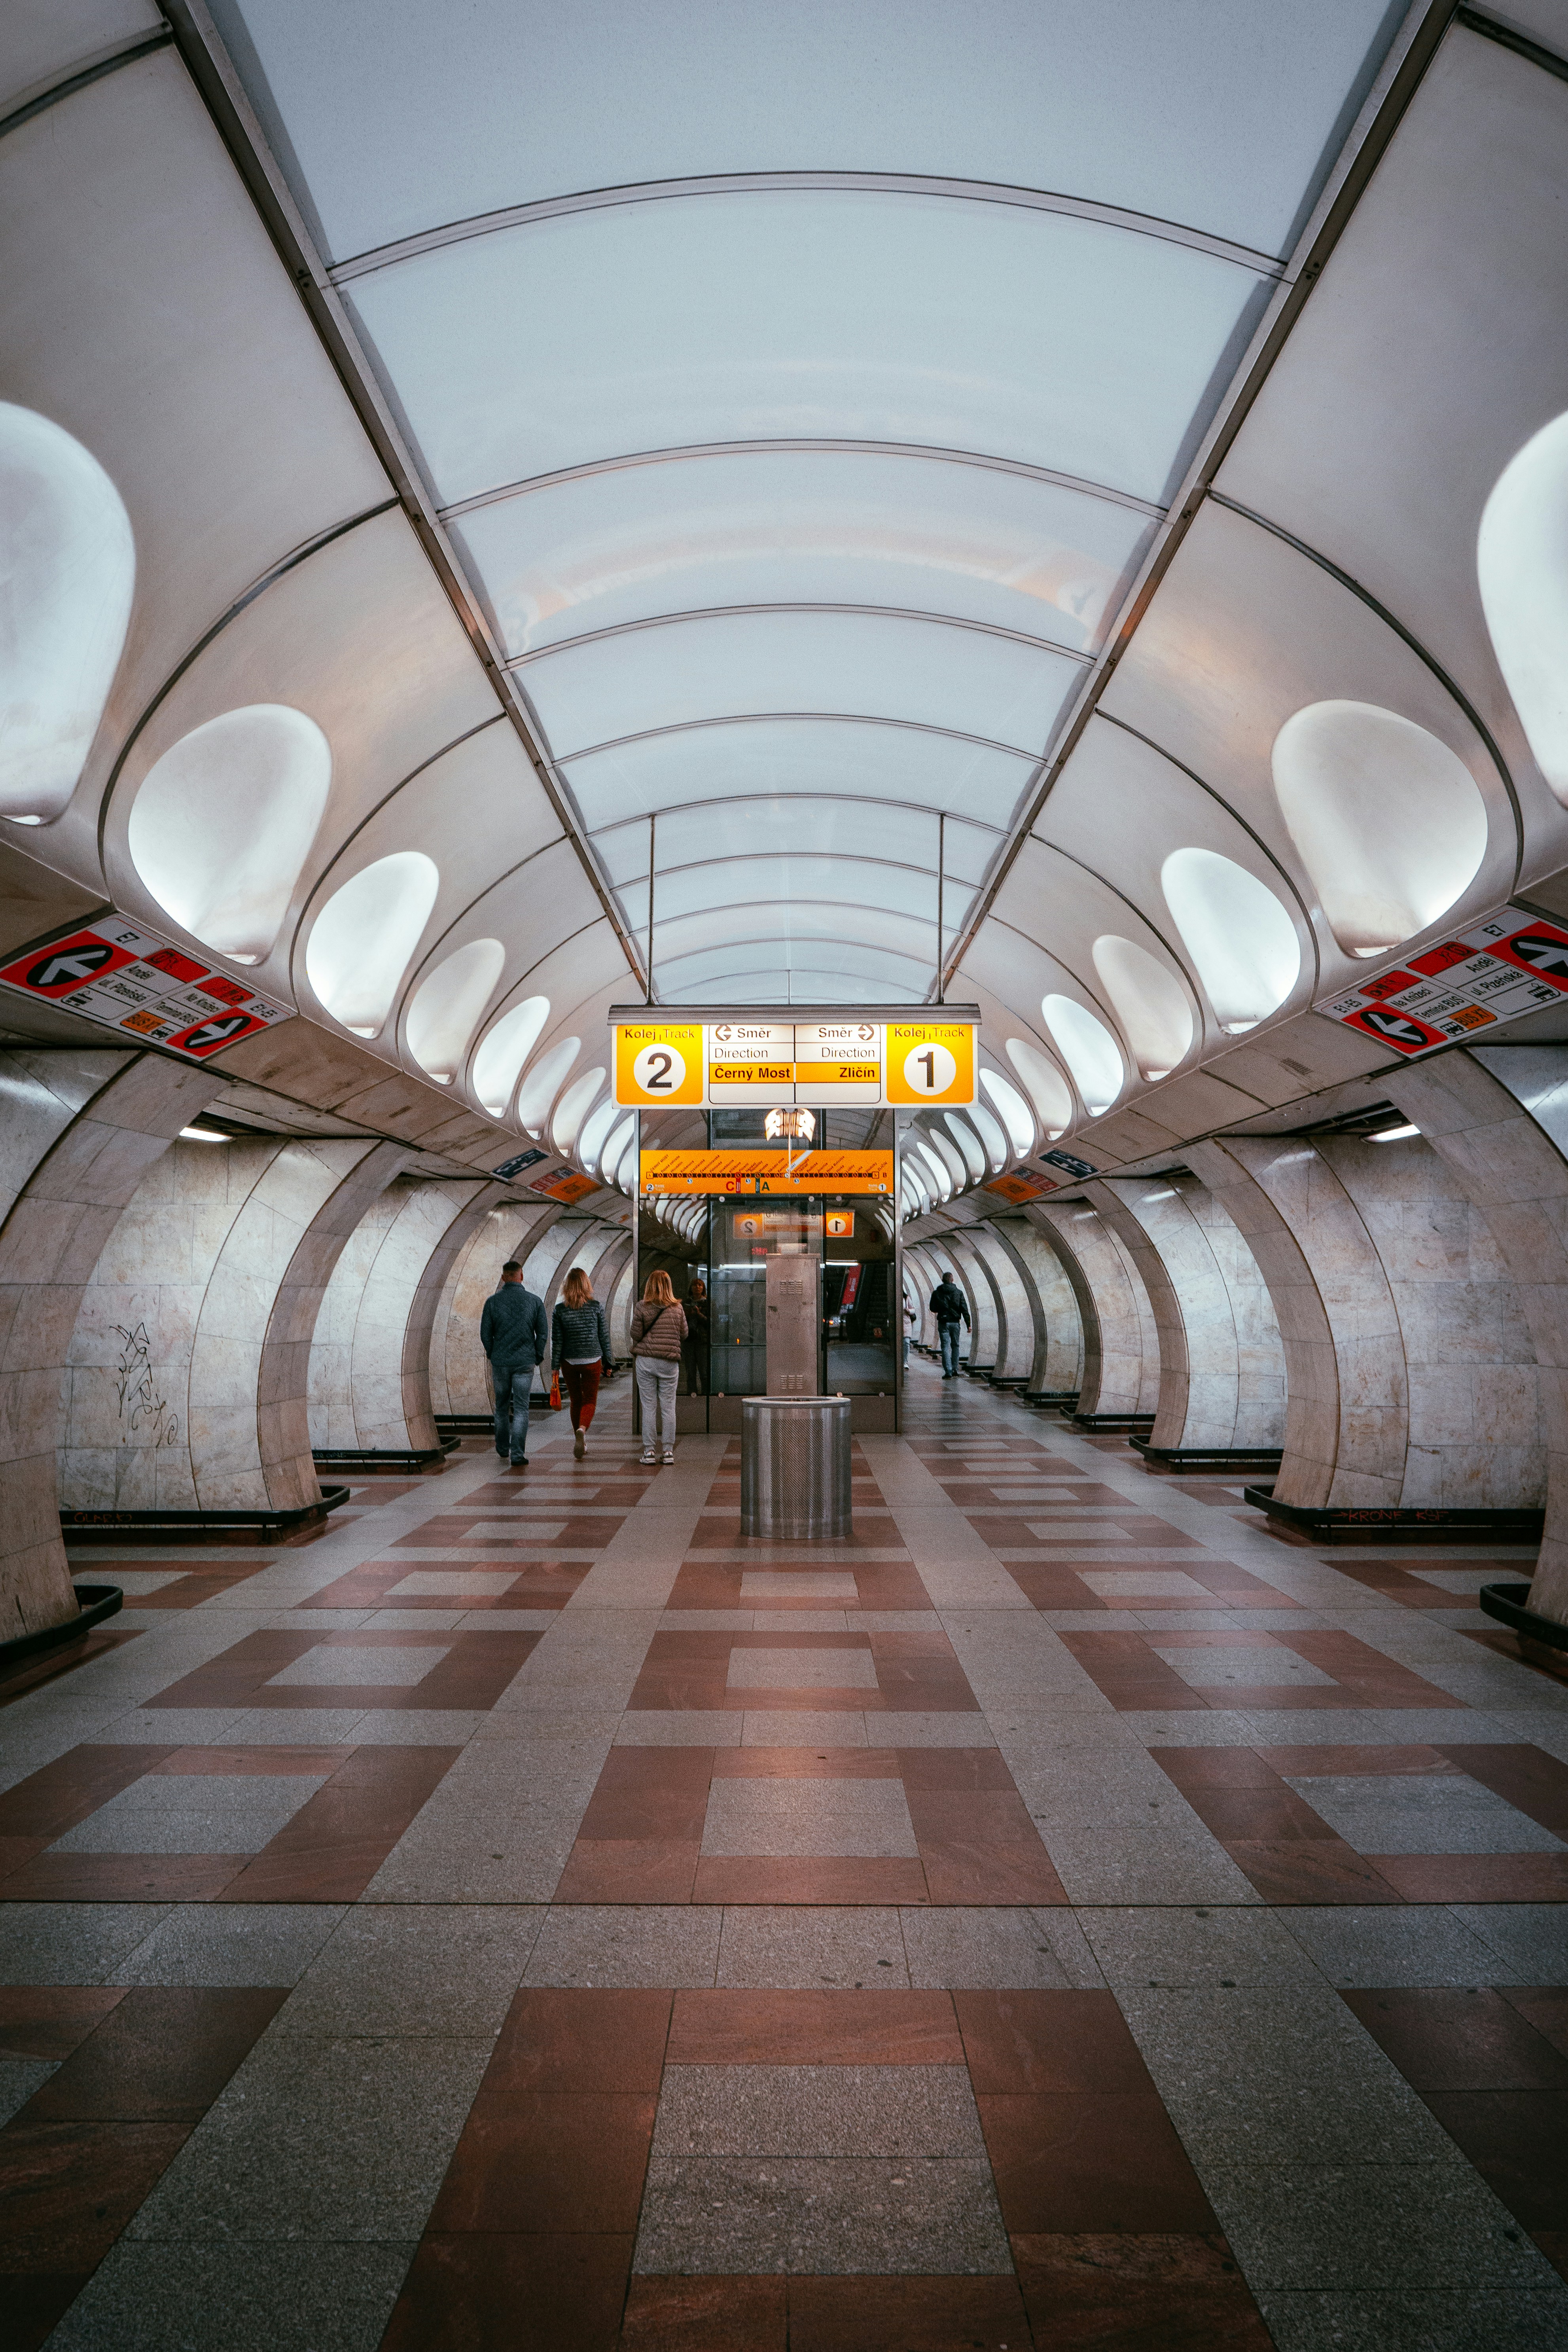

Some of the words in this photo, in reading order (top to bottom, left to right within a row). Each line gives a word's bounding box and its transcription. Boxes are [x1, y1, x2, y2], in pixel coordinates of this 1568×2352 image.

[1482, 924, 1506, 937] E7
[115, 932, 140, 944] E7
[1466, 956, 1497, 973] Anděl
[124, 965, 156, 980] Anděl
[1470, 987, 1487, 996] ul.
[1479, 969, 1524, 991] Plzeňská
[109, 983, 150, 1002] Plzeňská
[183, 993, 198, 1002] Na
[1390, 999, 1407, 1008] Na
[1403, 986, 1433, 1003] Knížecí
[1333, 999, 1362, 1013] E1-E5
[1442, 996, 1465, 1007] BUS
[250, 1004, 278, 1018] E1-E5
[1454, 1013, 1479, 1026] BUS
[1472, 1008, 1490, 1019] X7
[178, 1012, 199, 1024] BUS
[625, 1028, 656, 1040] Kolej
[663, 1028, 695, 1038] Track
[738, 1027, 771, 1038] Směr
[819, 1027, 852, 1038] Směr
[895, 1027, 925, 1039] Kolej
[932, 1027, 965, 1037] Track
[715, 1047, 768, 1058] Direction
[822, 1047, 875, 1058] Direction
[647, 1052, 672, 1088] 2
[715, 1065, 753, 1081] Černý
[759, 1068, 790, 1078] Most
[840, 1067, 875, 1078] Zličín
[918, 1051, 934, 1087] 1
[726, 1181, 735, 1191] C
[761, 1181, 770, 1191] A
